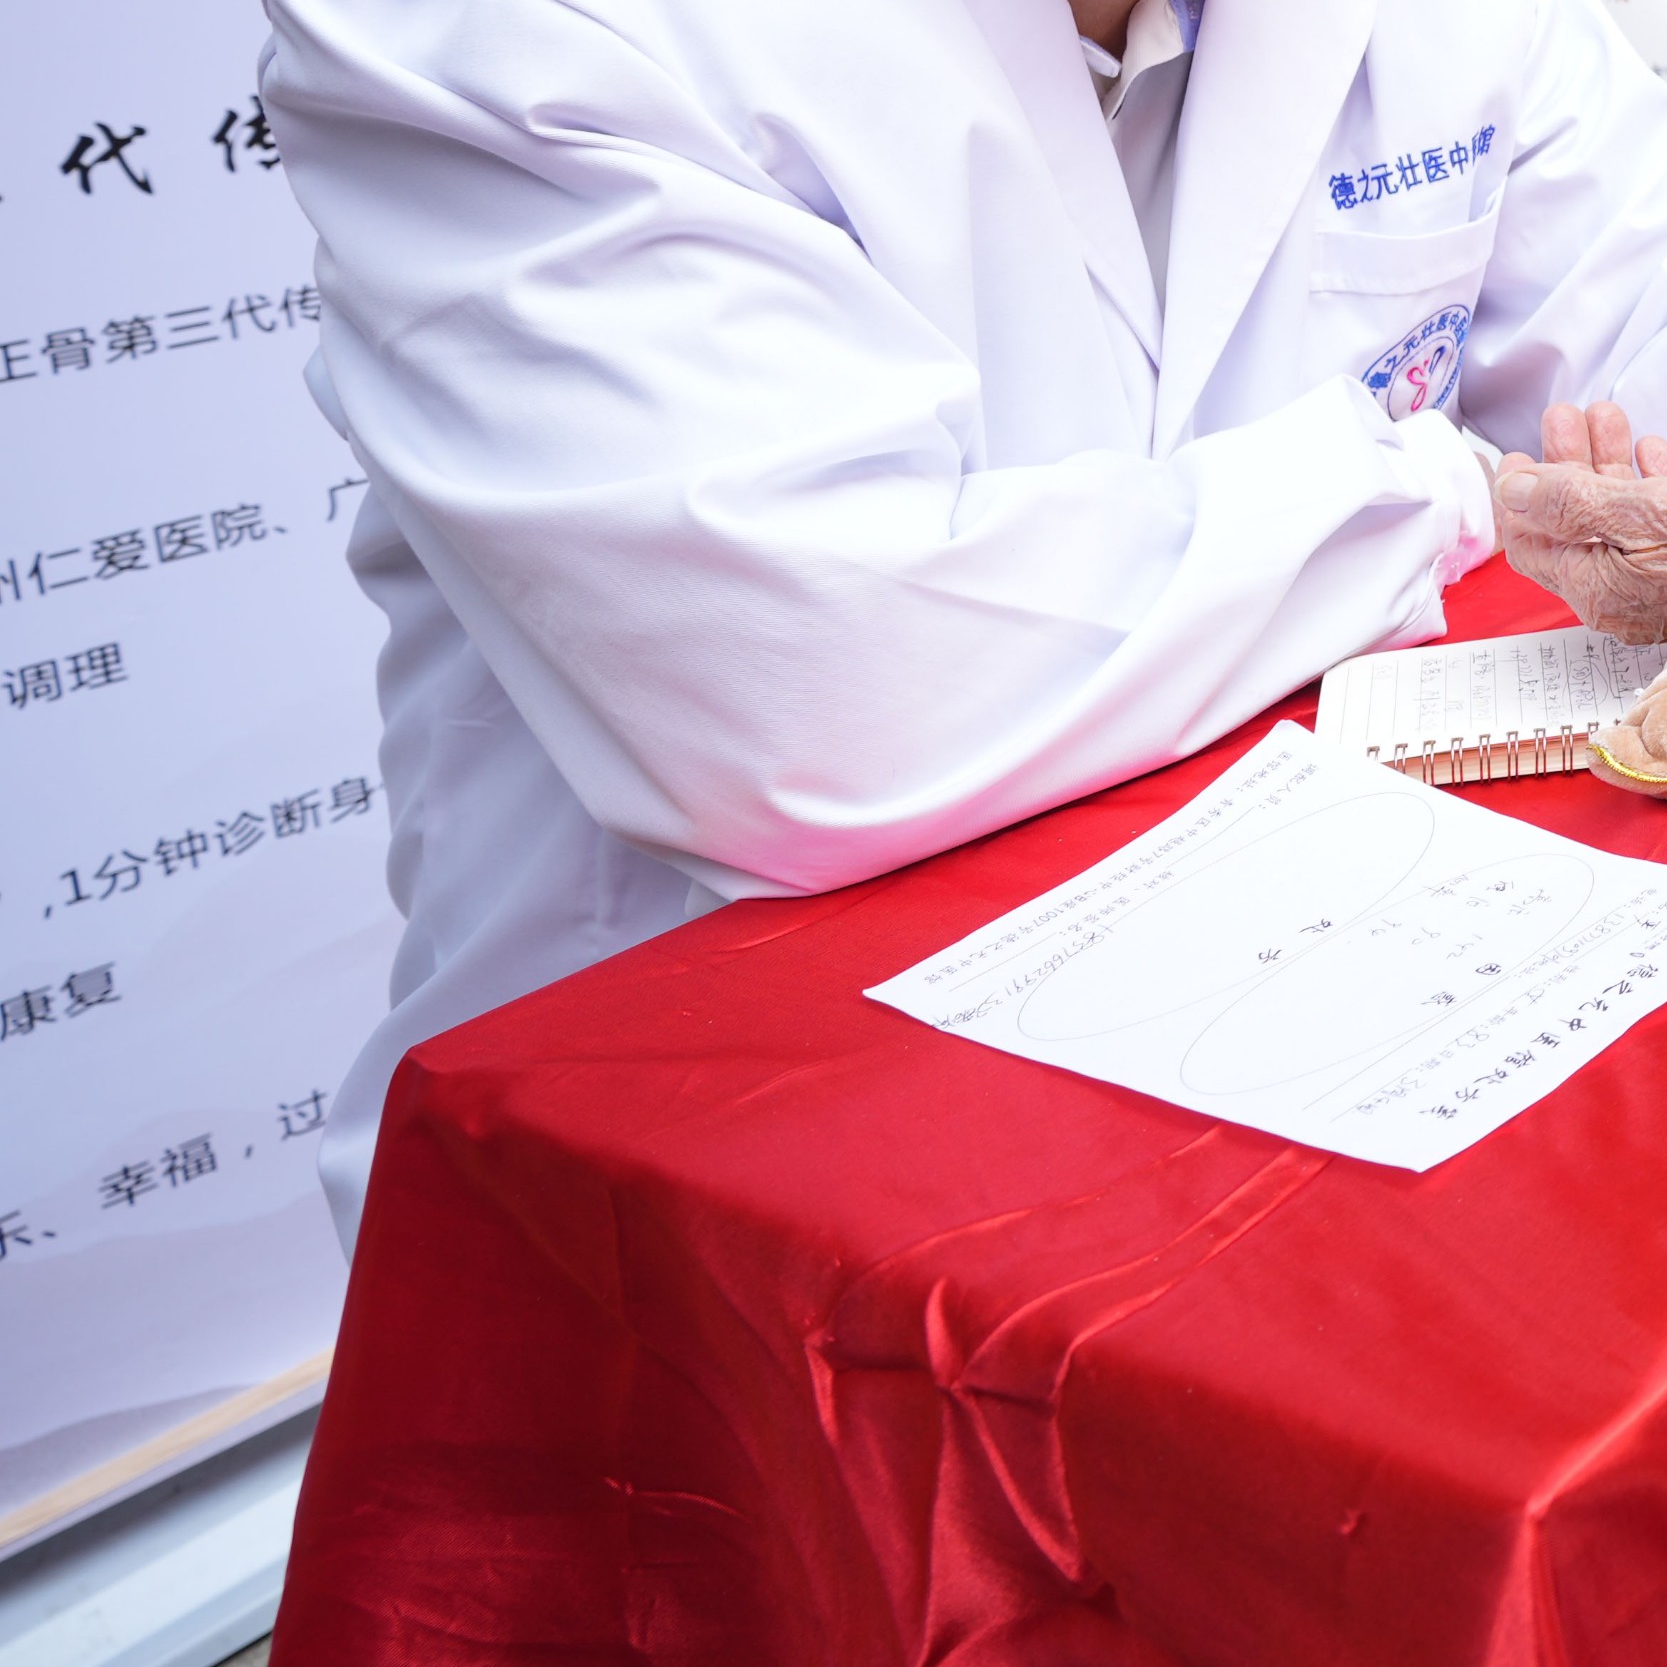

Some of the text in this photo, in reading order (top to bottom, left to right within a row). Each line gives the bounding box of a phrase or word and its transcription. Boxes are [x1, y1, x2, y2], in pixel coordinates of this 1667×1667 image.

[0, 283, 322, 384] 正骨第三代传
[2, 641, 129, 710] 调理
[43, 775, 387, 920] ，1分钟诊断身
[1257, 917, 1333, 964] 处方
[1445, 933, 1483, 959] 142
[0, 962, 122, 1042] 康复
[1418, 954, 1658, 1120] 德之元中医馆处方笺
[1451, 1027, 1490, 1048] 83
